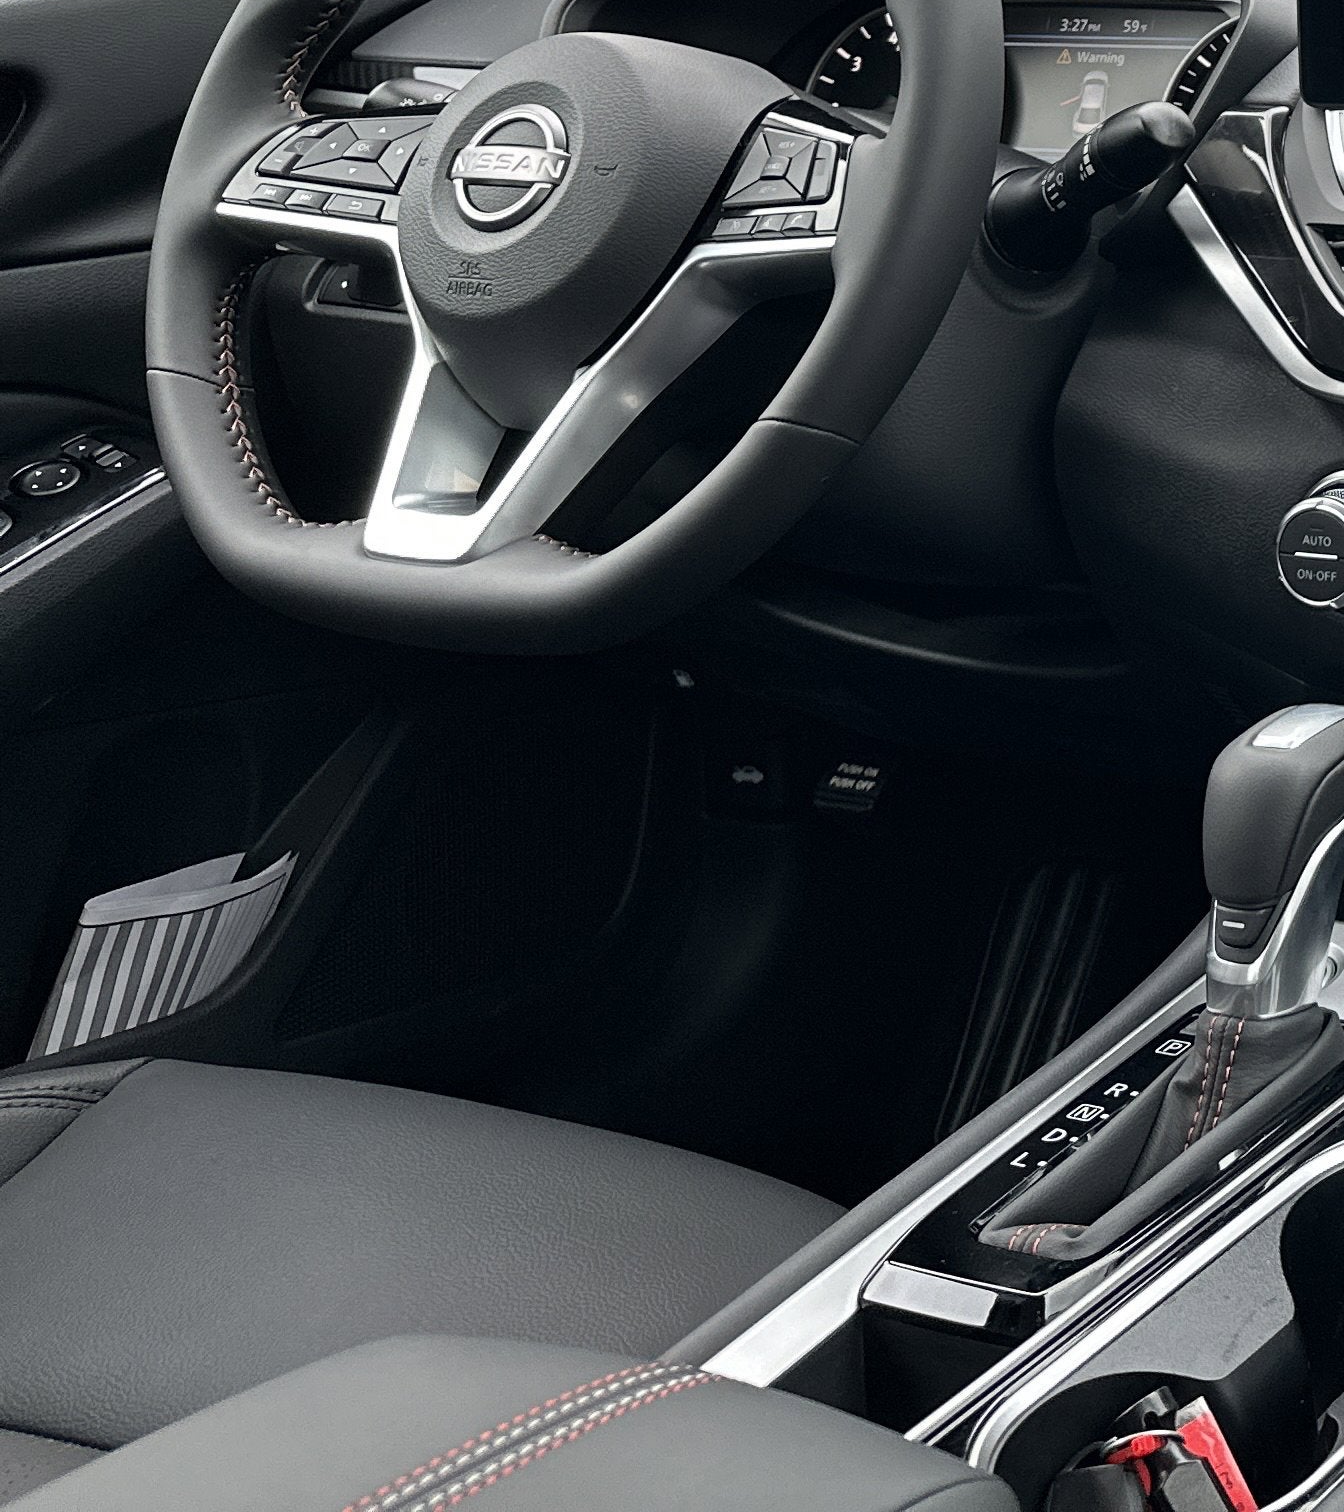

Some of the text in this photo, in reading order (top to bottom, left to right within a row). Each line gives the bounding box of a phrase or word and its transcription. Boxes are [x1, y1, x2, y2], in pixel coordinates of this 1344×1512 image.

[850, 55, 862, 72] 3
[1077, 51, 1125, 67] Warning
[452, 152, 567, 179] NISSAN
[1302, 534, 1332, 548] AUTO
[829, 775, 876, 793] PUSH OFF
[1103, 1082, 1129, 1098] R
[1041, 1127, 1068, 1142] D
[1010, 1151, 1029, 1168] L
